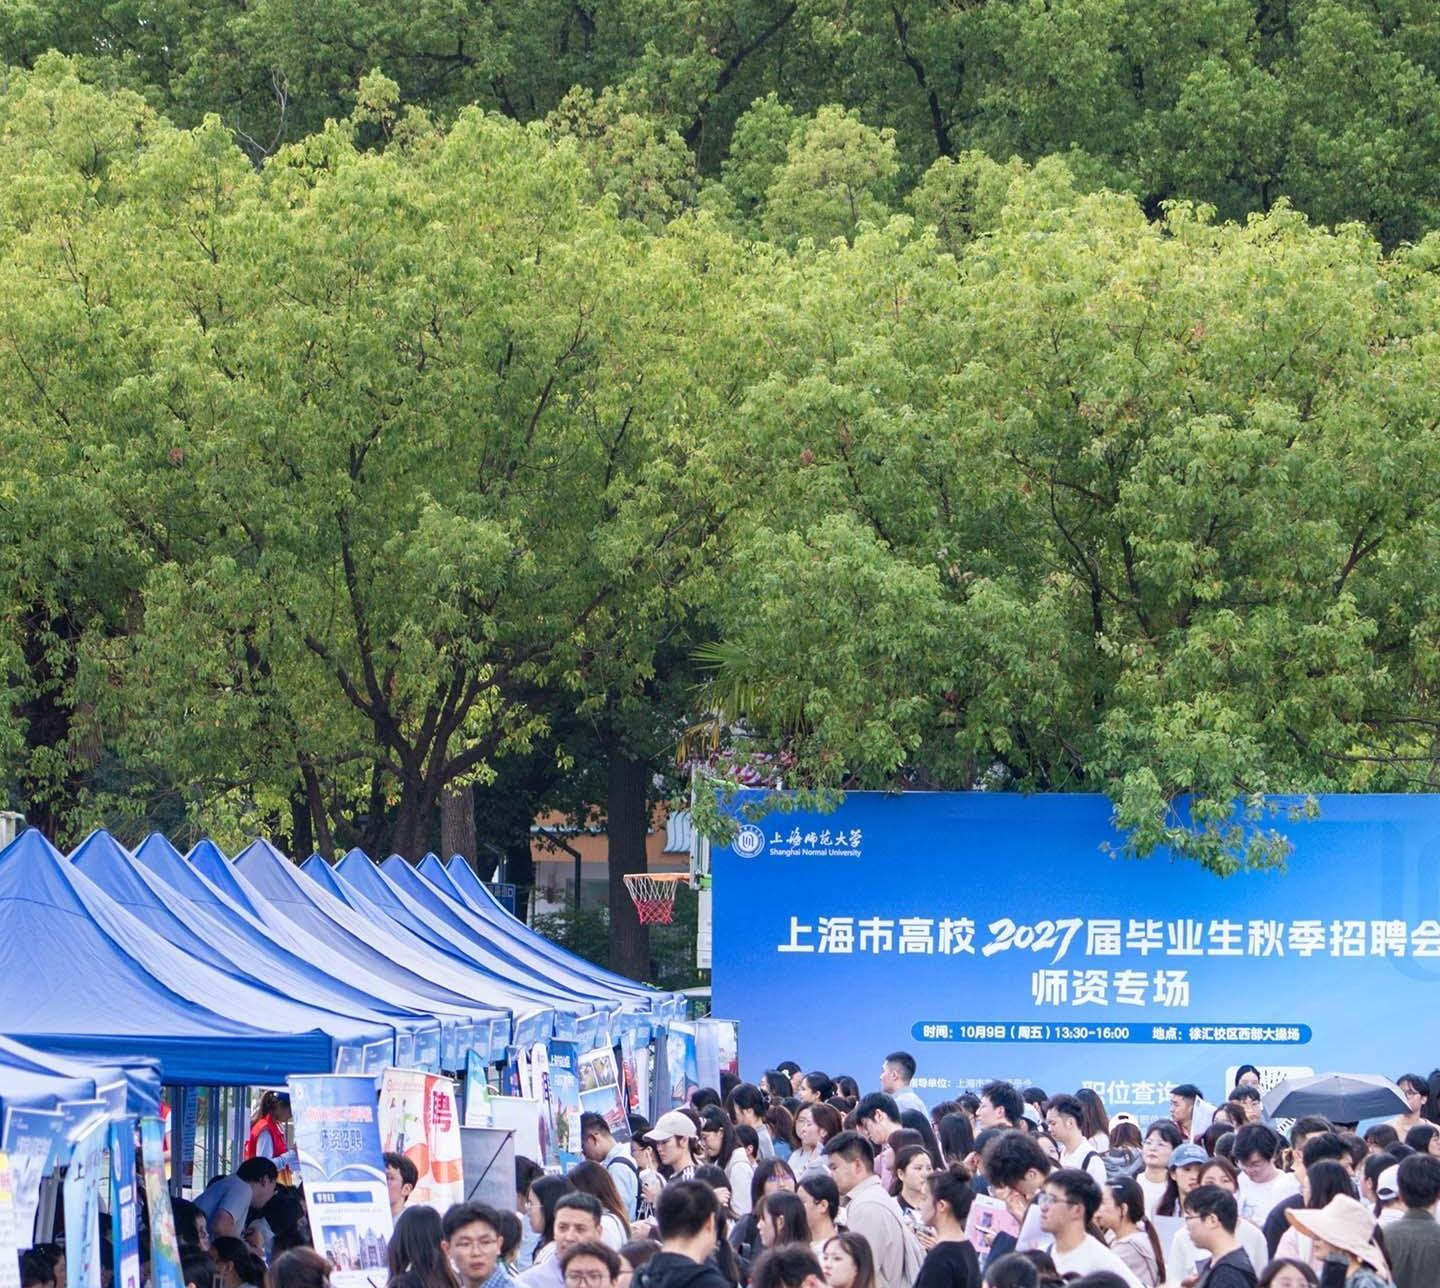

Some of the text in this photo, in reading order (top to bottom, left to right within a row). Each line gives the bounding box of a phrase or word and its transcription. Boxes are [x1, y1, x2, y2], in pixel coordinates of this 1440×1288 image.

[769, 826, 862, 848] 上海师范大学
[769, 848, 801, 857] Shanghai
[828, 849, 862, 858] University
[1031, 967, 1190, 1007] 师资专场
[1152, 1027, 1300, 1042] 地点：徐汇校区西部大操场
